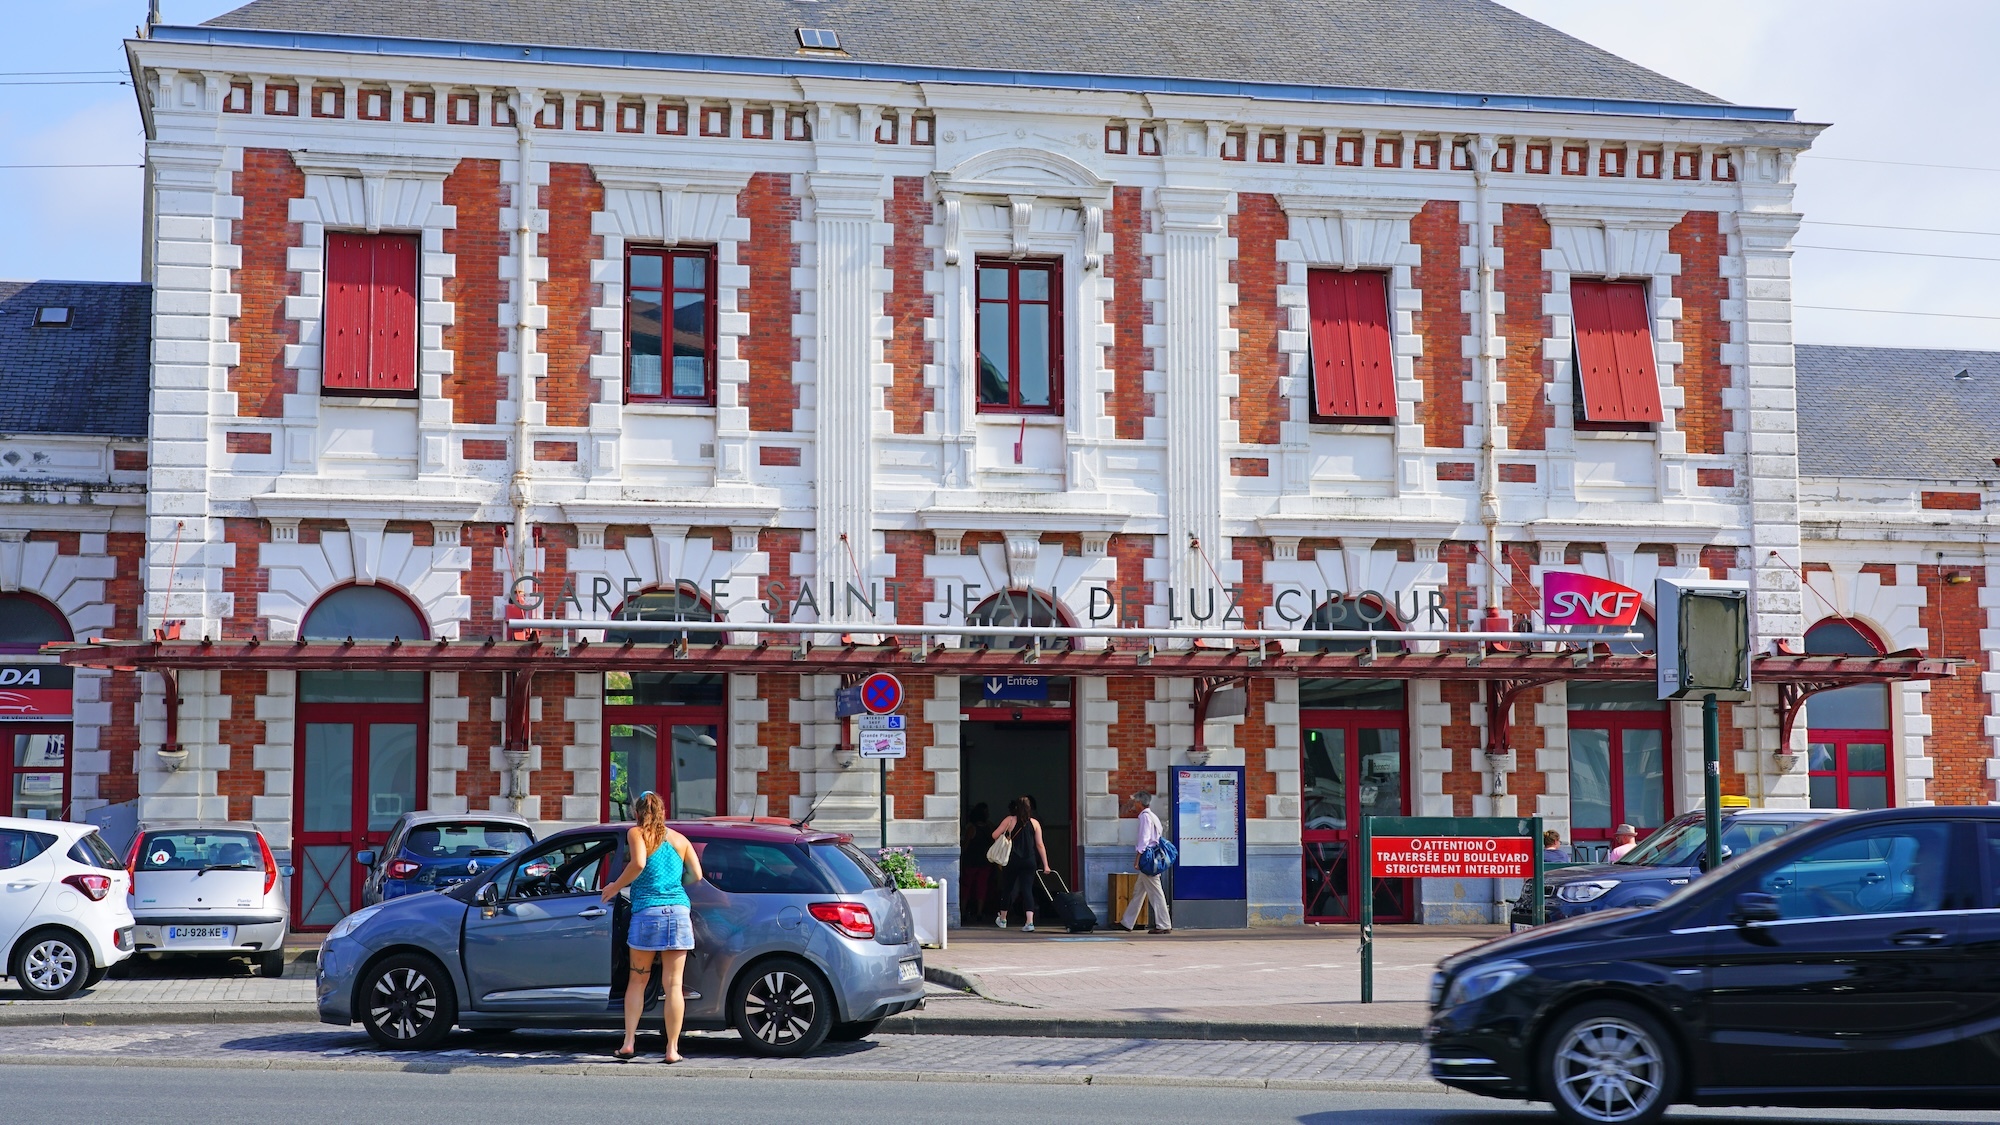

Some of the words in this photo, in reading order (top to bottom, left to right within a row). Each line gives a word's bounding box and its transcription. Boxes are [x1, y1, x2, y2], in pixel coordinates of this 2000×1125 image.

[510, 576, 642, 613] GARE
[675, 578, 730, 614] DE
[761, 580, 906, 618] SAINT
[938, 584, 1057, 620] JEAN
[1089, 586, 1139, 621] DE
[1168, 587, 1245, 622] LUZ
[1275, 588, 1474, 624] CIBOURE
[1549, 591, 1639, 618] SNCF
[0, 668, 41, 685] DA
[1007, 676, 1039, 686] Entrée
[1423, 840, 1483, 850] ATTENTION
[155, 854, 165, 862] A
[1377, 851, 1439, 862] TRAVERSÉE
[1444, 852, 1459, 862] DU
[1463, 853, 1529, 863] BOULEVARD
[1385, 864, 1461, 874] STRICTEMENT
[1465, 864, 1521, 874] INTERDITE
[176, 928, 221, 937] CJ-928-KE
